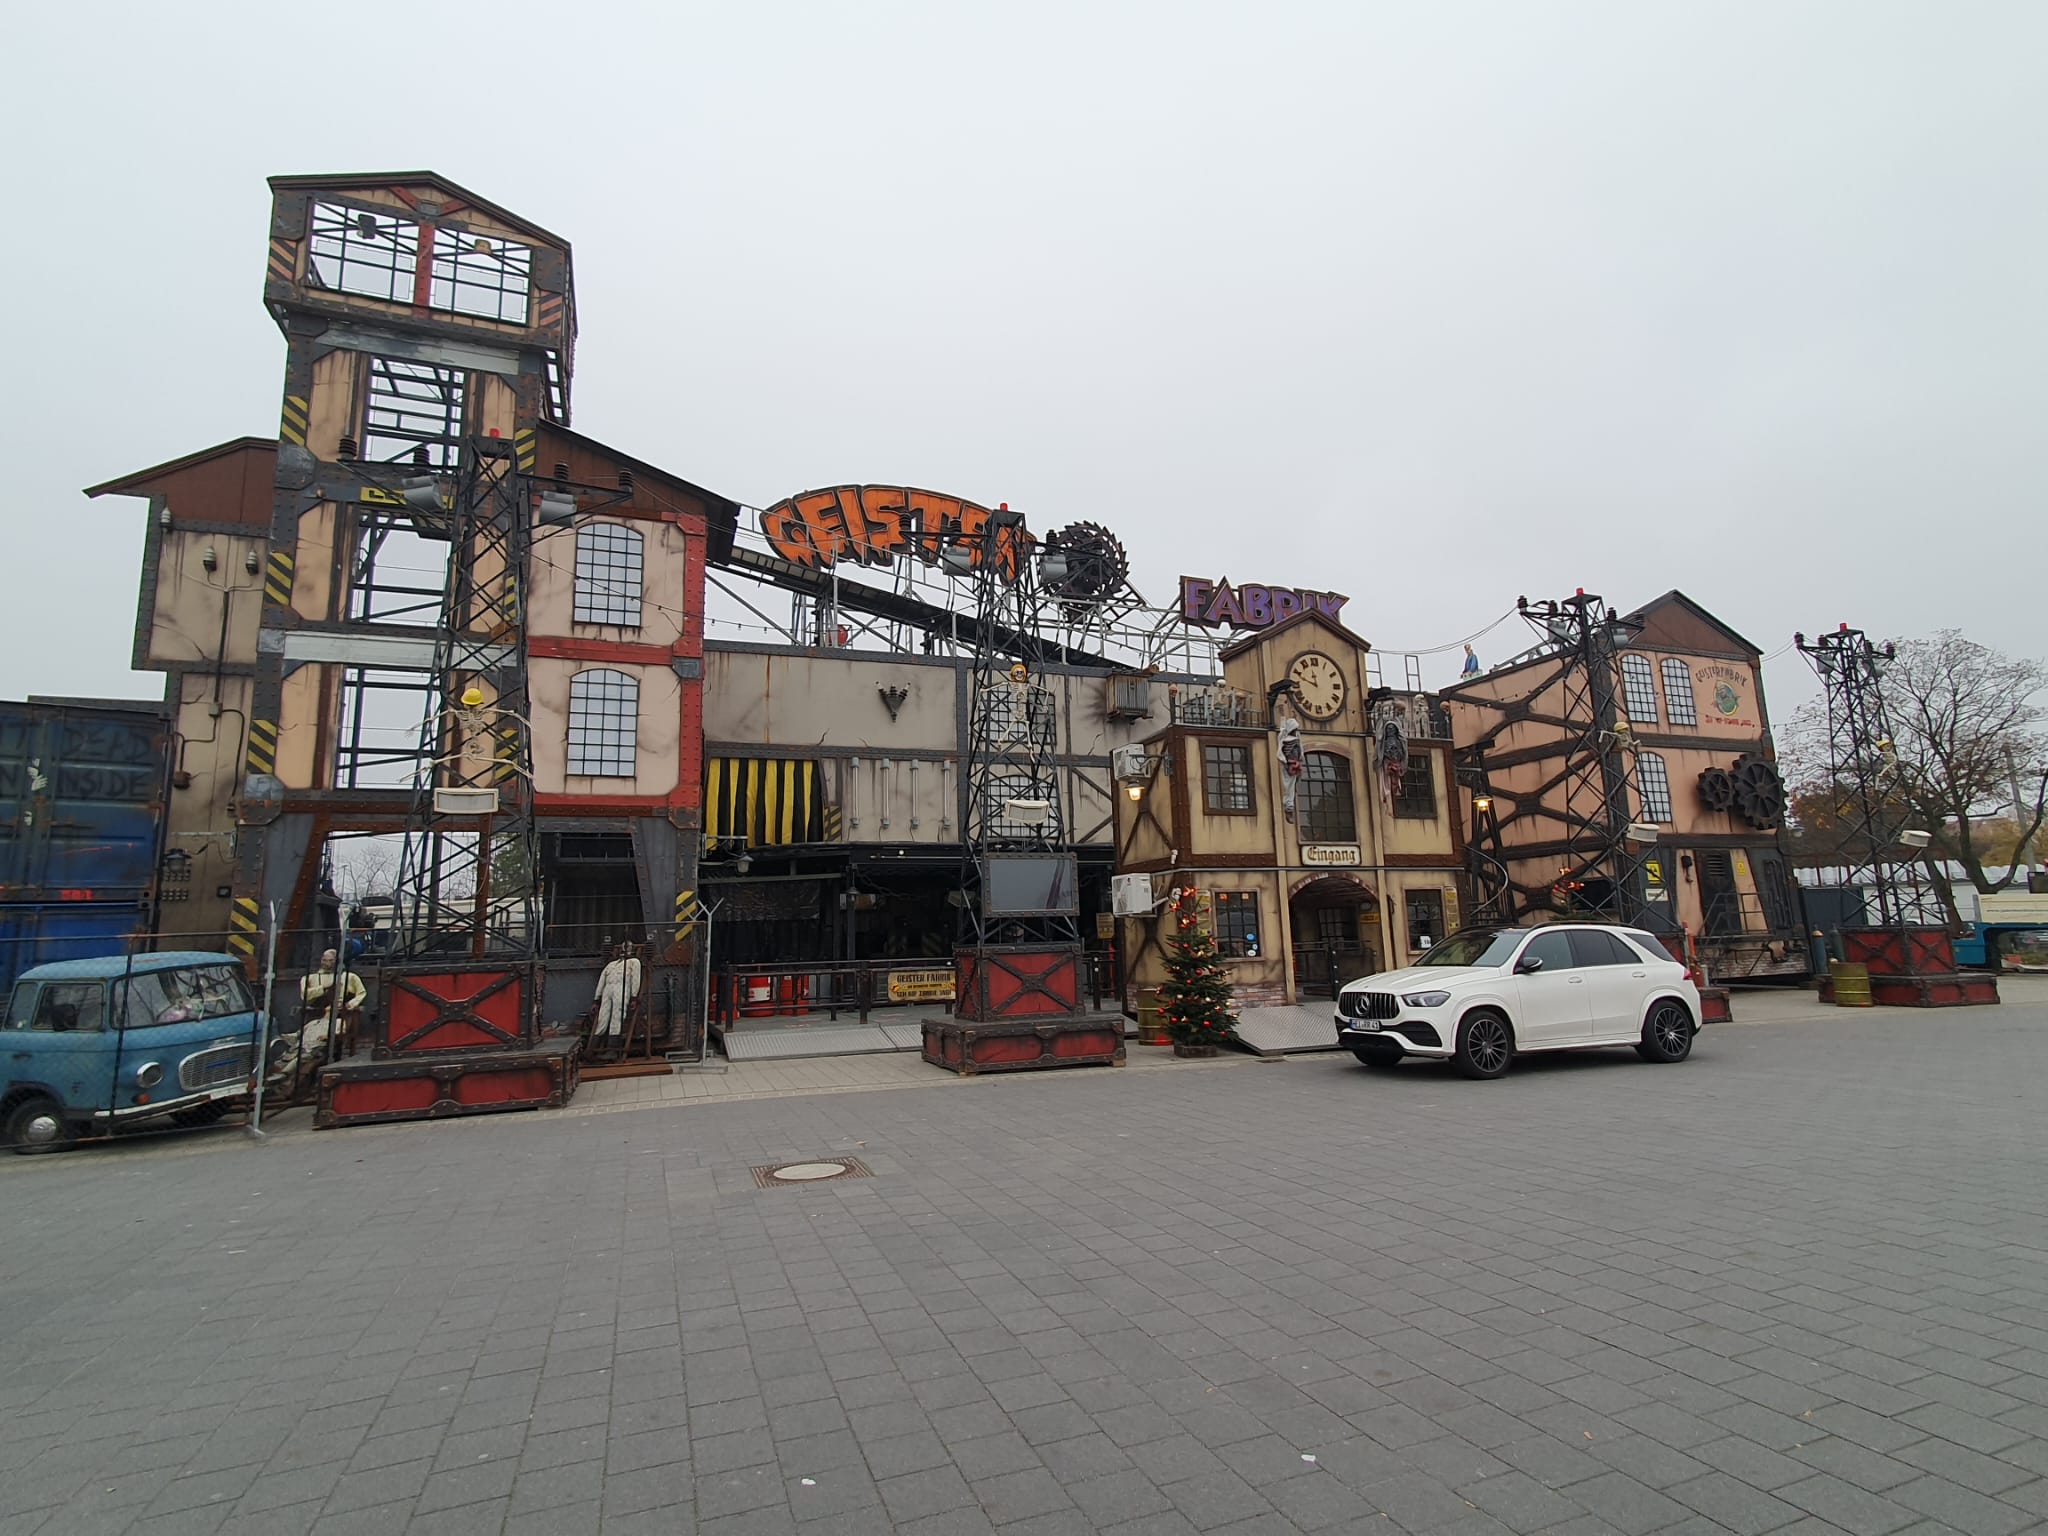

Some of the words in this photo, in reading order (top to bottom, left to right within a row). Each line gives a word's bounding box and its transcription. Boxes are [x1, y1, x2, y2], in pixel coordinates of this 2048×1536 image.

[759, 484, 1037, 587] GEISTER
[1180, 575, 1350, 632] FABRIK
[1307, 846, 1356, 865] Eingang
